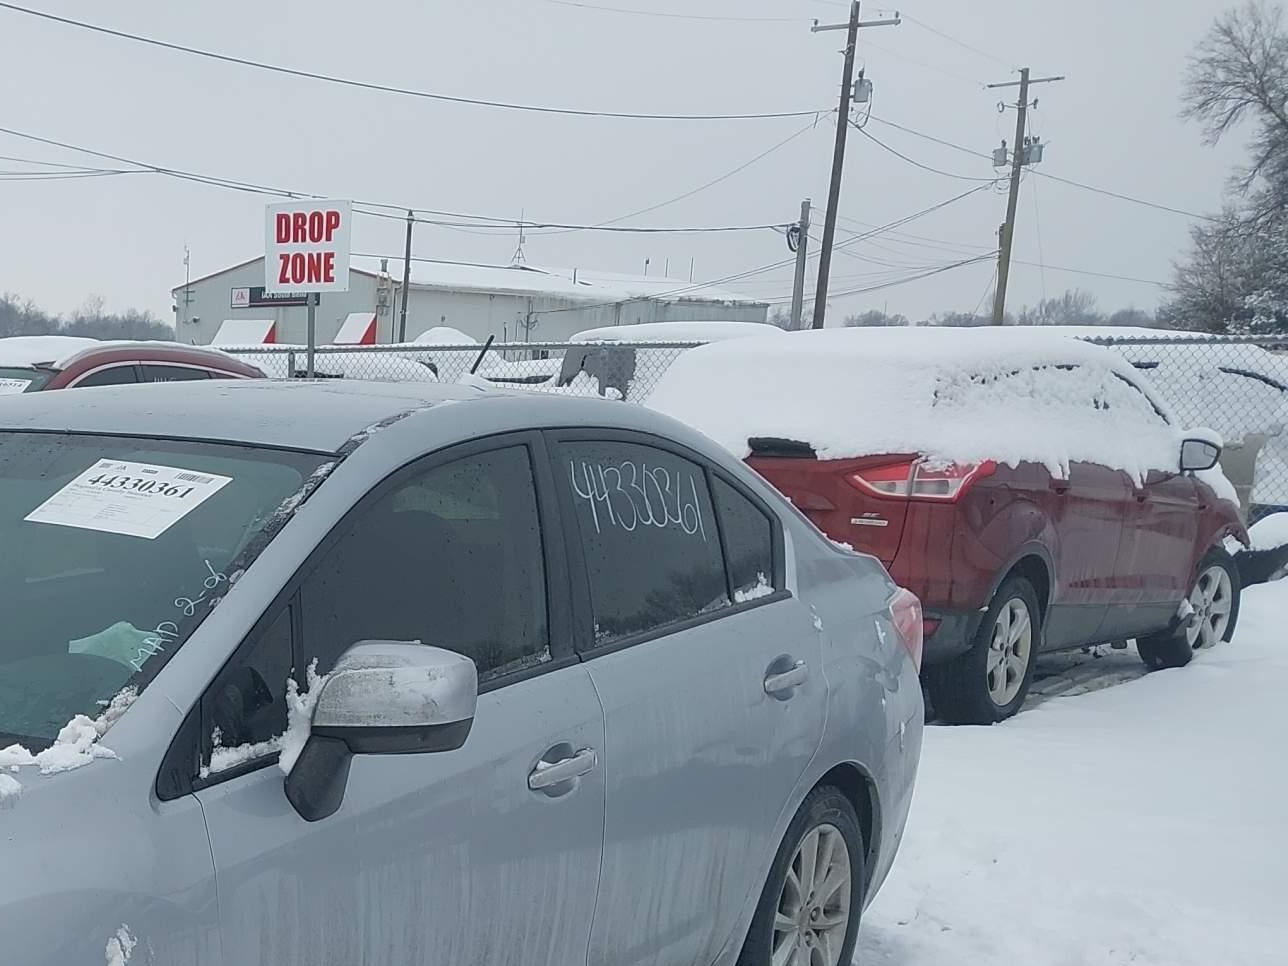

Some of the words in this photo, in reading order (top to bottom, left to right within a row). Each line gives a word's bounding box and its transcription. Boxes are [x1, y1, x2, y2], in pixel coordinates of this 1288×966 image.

[276, 210, 340, 243] DROP
[279, 252, 335, 284] ZONE
[88, 473, 195, 499] 44330361
[570, 460, 707, 542] 44330361
[130, 621, 179, 672] MAD
